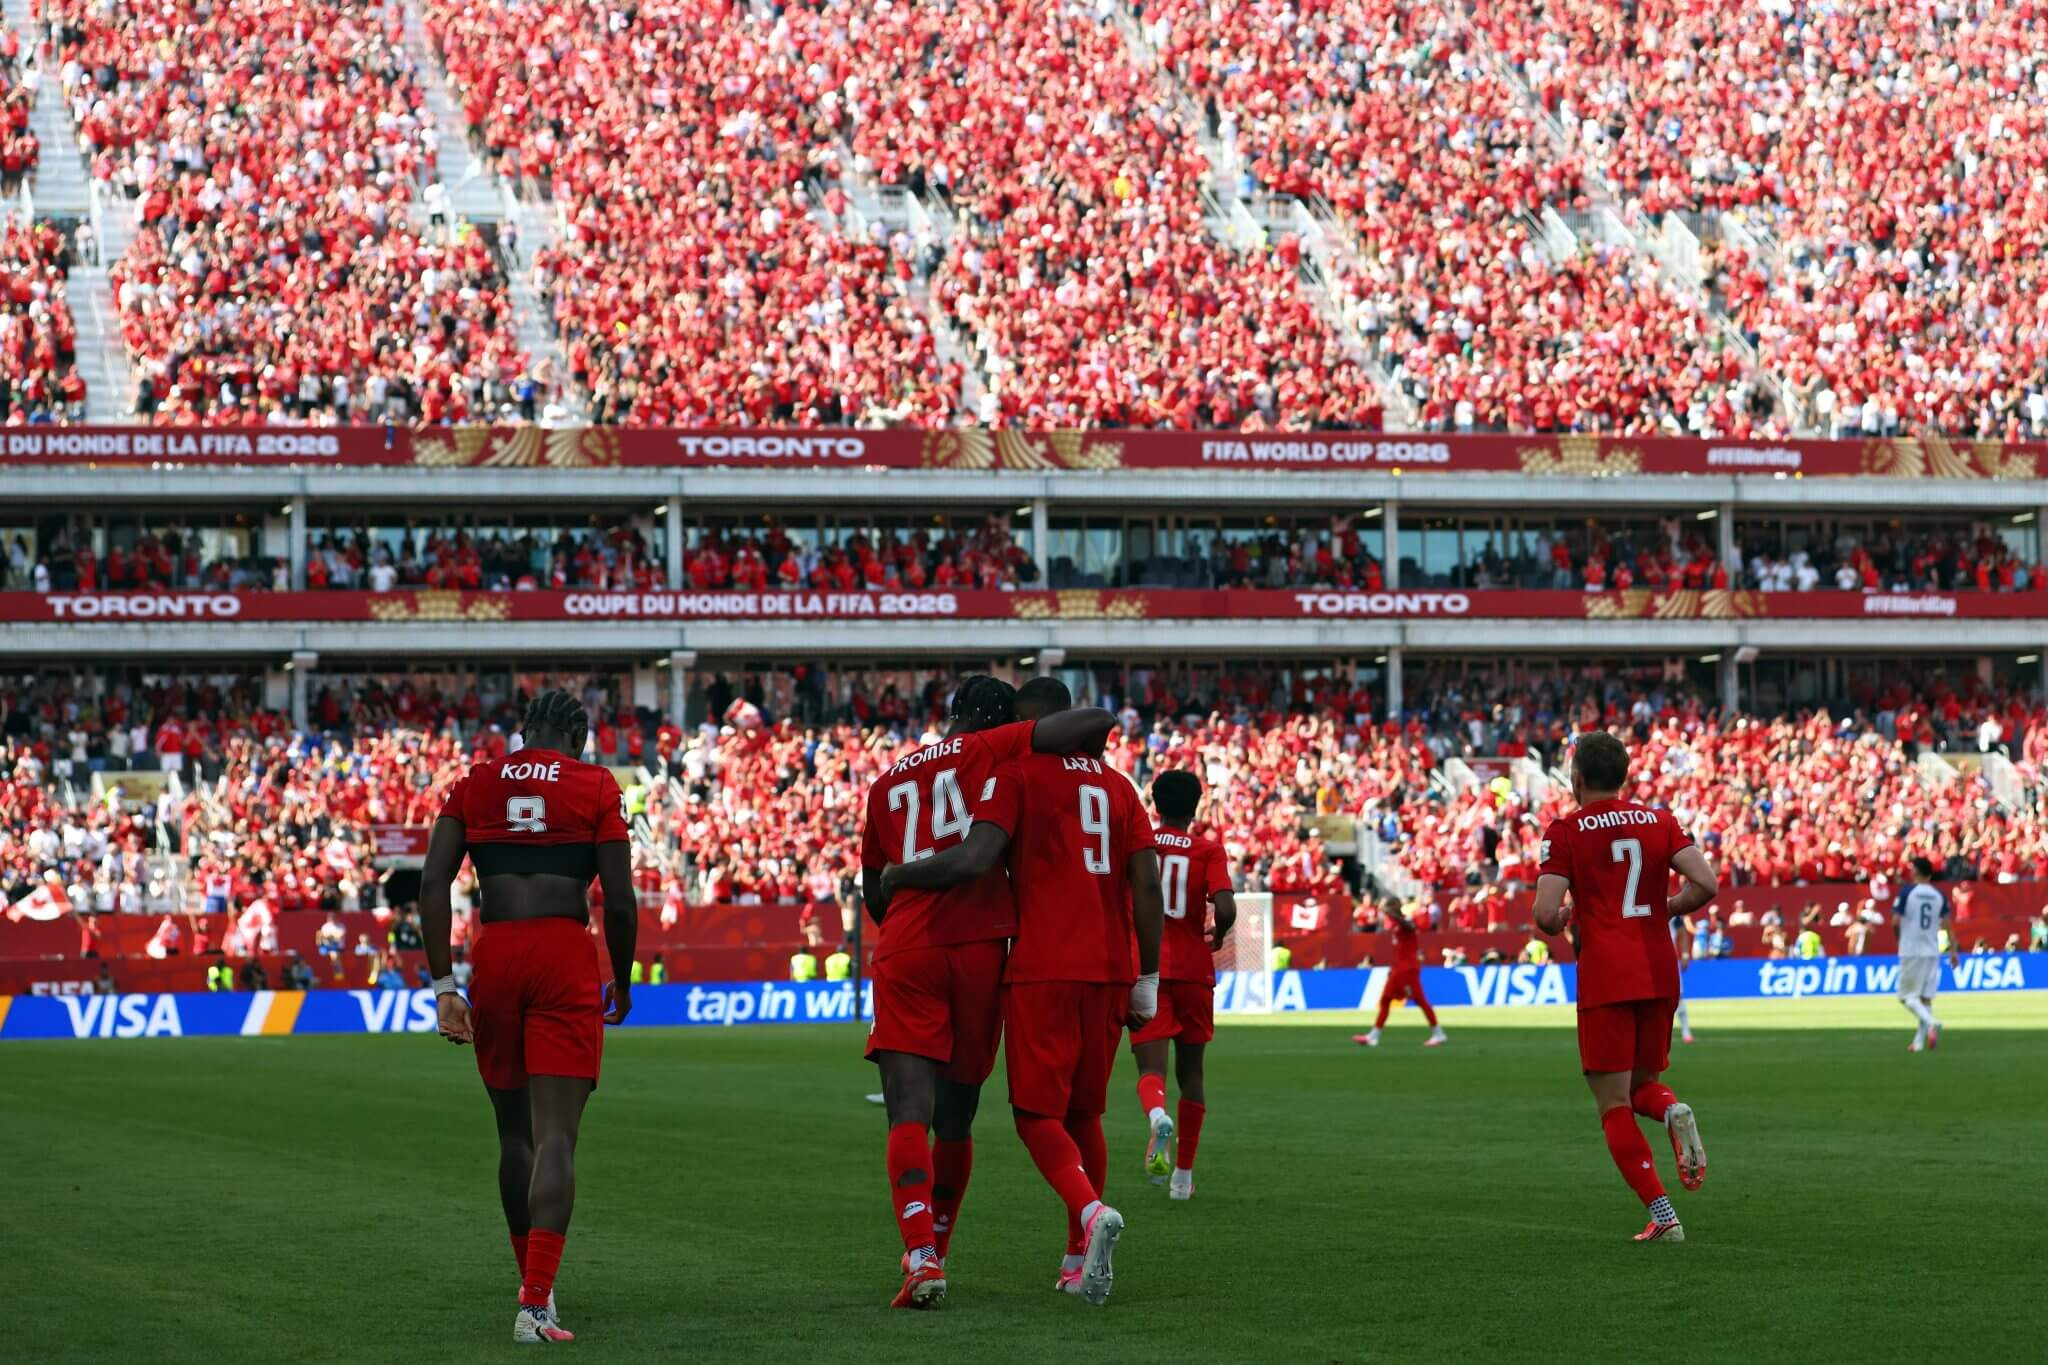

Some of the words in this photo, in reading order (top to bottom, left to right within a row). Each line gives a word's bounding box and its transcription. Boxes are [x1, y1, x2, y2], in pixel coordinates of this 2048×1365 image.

[8, 434, 42, 455] DU
[46, 434, 129, 455] MONDE
[132, 434, 164, 455] DE
[167, 434, 198, 455] LA
[201, 434, 252, 455] FIFA
[256, 434, 339, 455] 2026
[678, 436, 865, 458] TORONTO
[1202, 441, 1249, 461] FIFA
[1251, 441, 1329, 461] WORLD
[1331, 442, 1374, 462] CUP
[1376, 442, 1450, 462] 2026
[46, 595, 241, 616] TORONTO
[564, 594, 640, 615] COUPE
[643, 594, 675, 614] DU
[678, 594, 758, 614] MONDE
[761, 594, 792, 614] DE
[795, 594, 823, 614] LA
[826, 594, 875, 614] FIFA
[880, 594, 958, 614] 2026
[1295, 594, 1470, 614] TORONTO
[501, 761, 561, 782] KONÉ
[890, 738, 963, 776] PROMISE
[888, 768, 974, 864] 24
[1079, 784, 1111, 875] 9
[1578, 810, 1658, 831] JOHNSTON
[1157, 854, 1190, 919] 0
[1611, 838, 1652, 919] 2
[1920, 903, 1932, 930] 6
[31, 981, 95, 996] FIFA
[1455, 965, 1568, 1006] VISA
[1759, 961, 1822, 998] tap
[1823, 958, 1857, 993] in
[1943, 956, 2025, 990] VISA
[55, 993, 183, 1038] VISA
[348, 988, 438, 1032] VIS
[686, 986, 755, 1026] tap
[758, 982, 796, 1019] in
